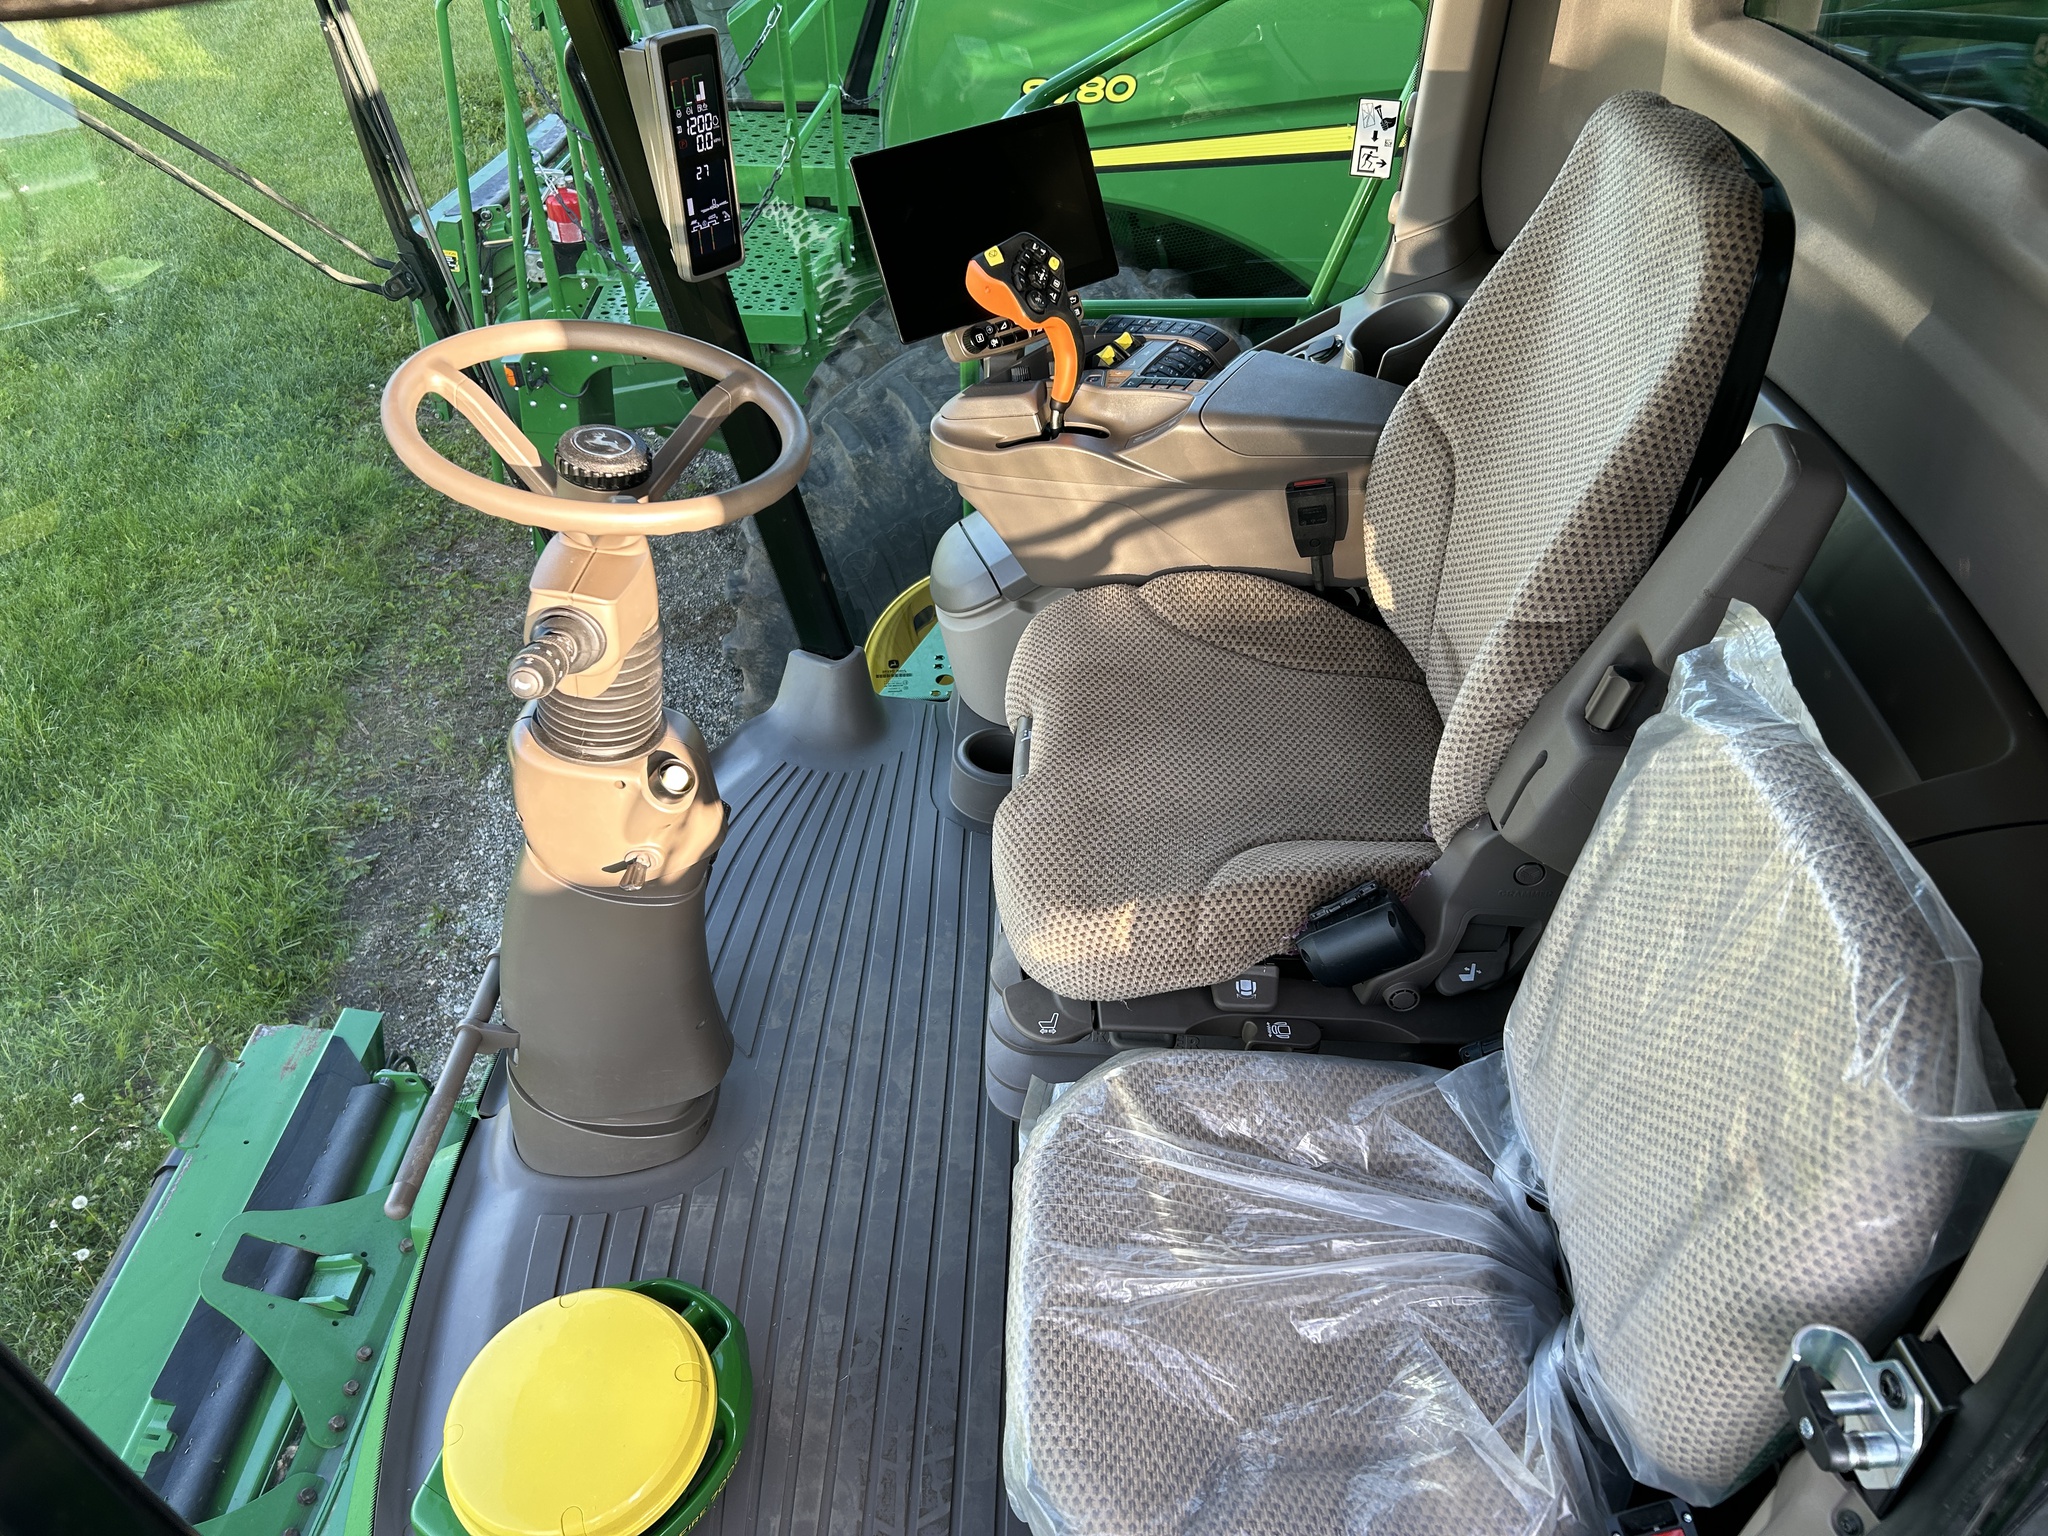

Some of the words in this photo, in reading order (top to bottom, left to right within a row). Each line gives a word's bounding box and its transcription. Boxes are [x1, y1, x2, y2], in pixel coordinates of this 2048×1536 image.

[686, 112, 713, 136] 1200
[695, 131, 714, 153] 0.0
[696, 164, 710, 180] 27
[710, 1449, 742, 1503] 7000
